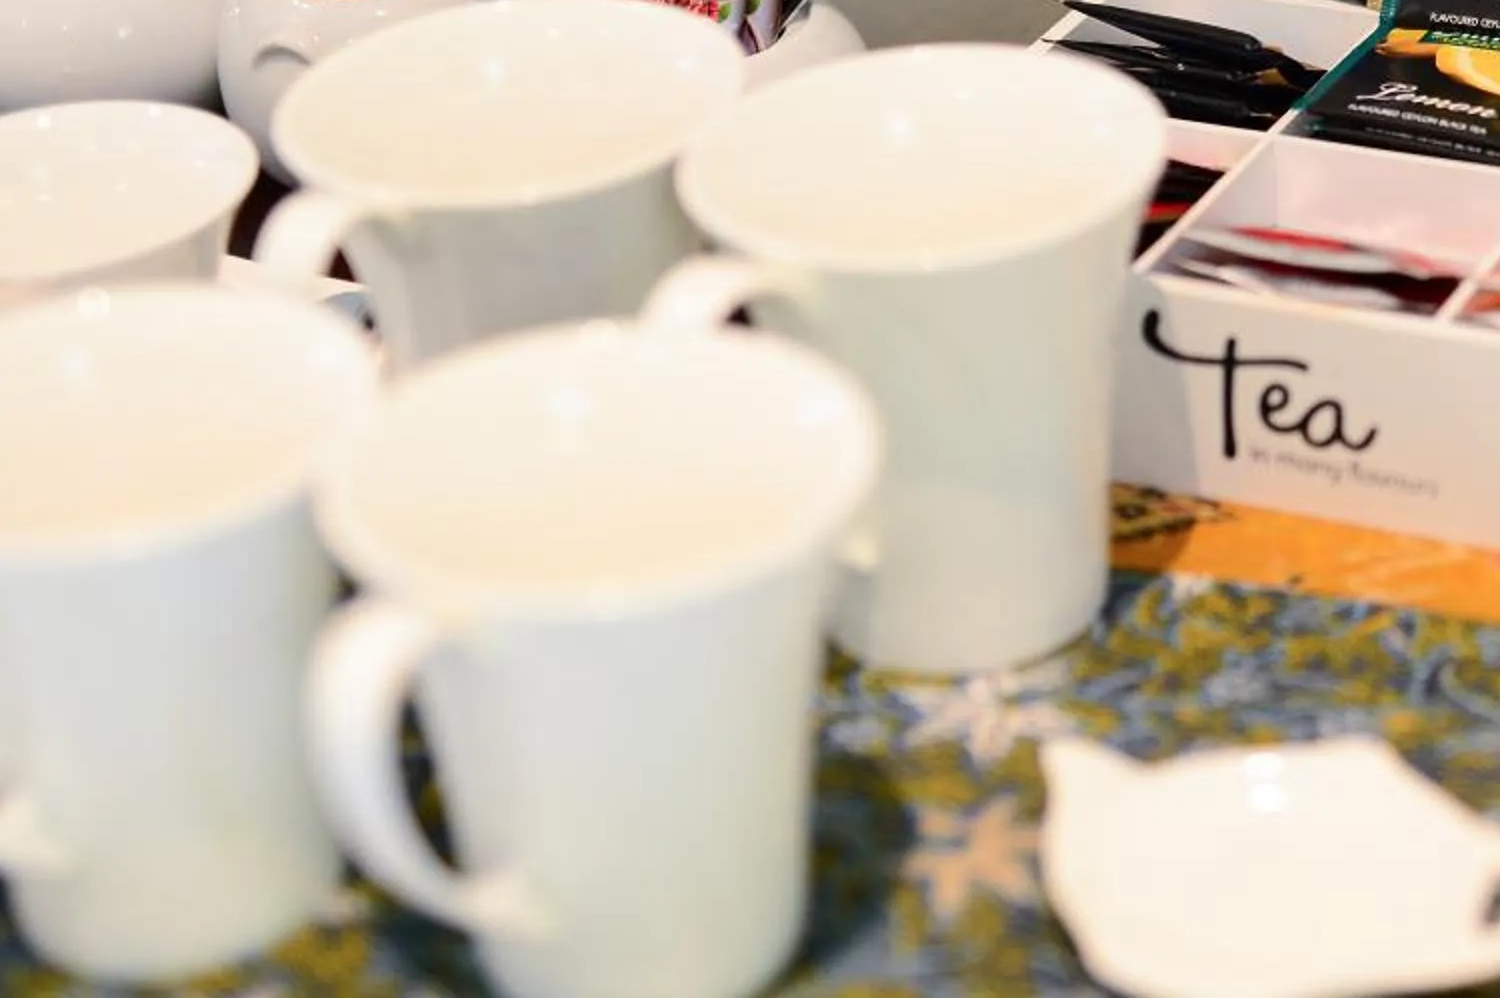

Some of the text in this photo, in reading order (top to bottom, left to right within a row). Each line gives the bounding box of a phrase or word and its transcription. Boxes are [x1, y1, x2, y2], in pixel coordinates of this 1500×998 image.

[1430, 12, 1479, 26] FLAVOURED
[1356, 82, 1498, 119] Lemon
[1141, 309, 1379, 458] Tea
